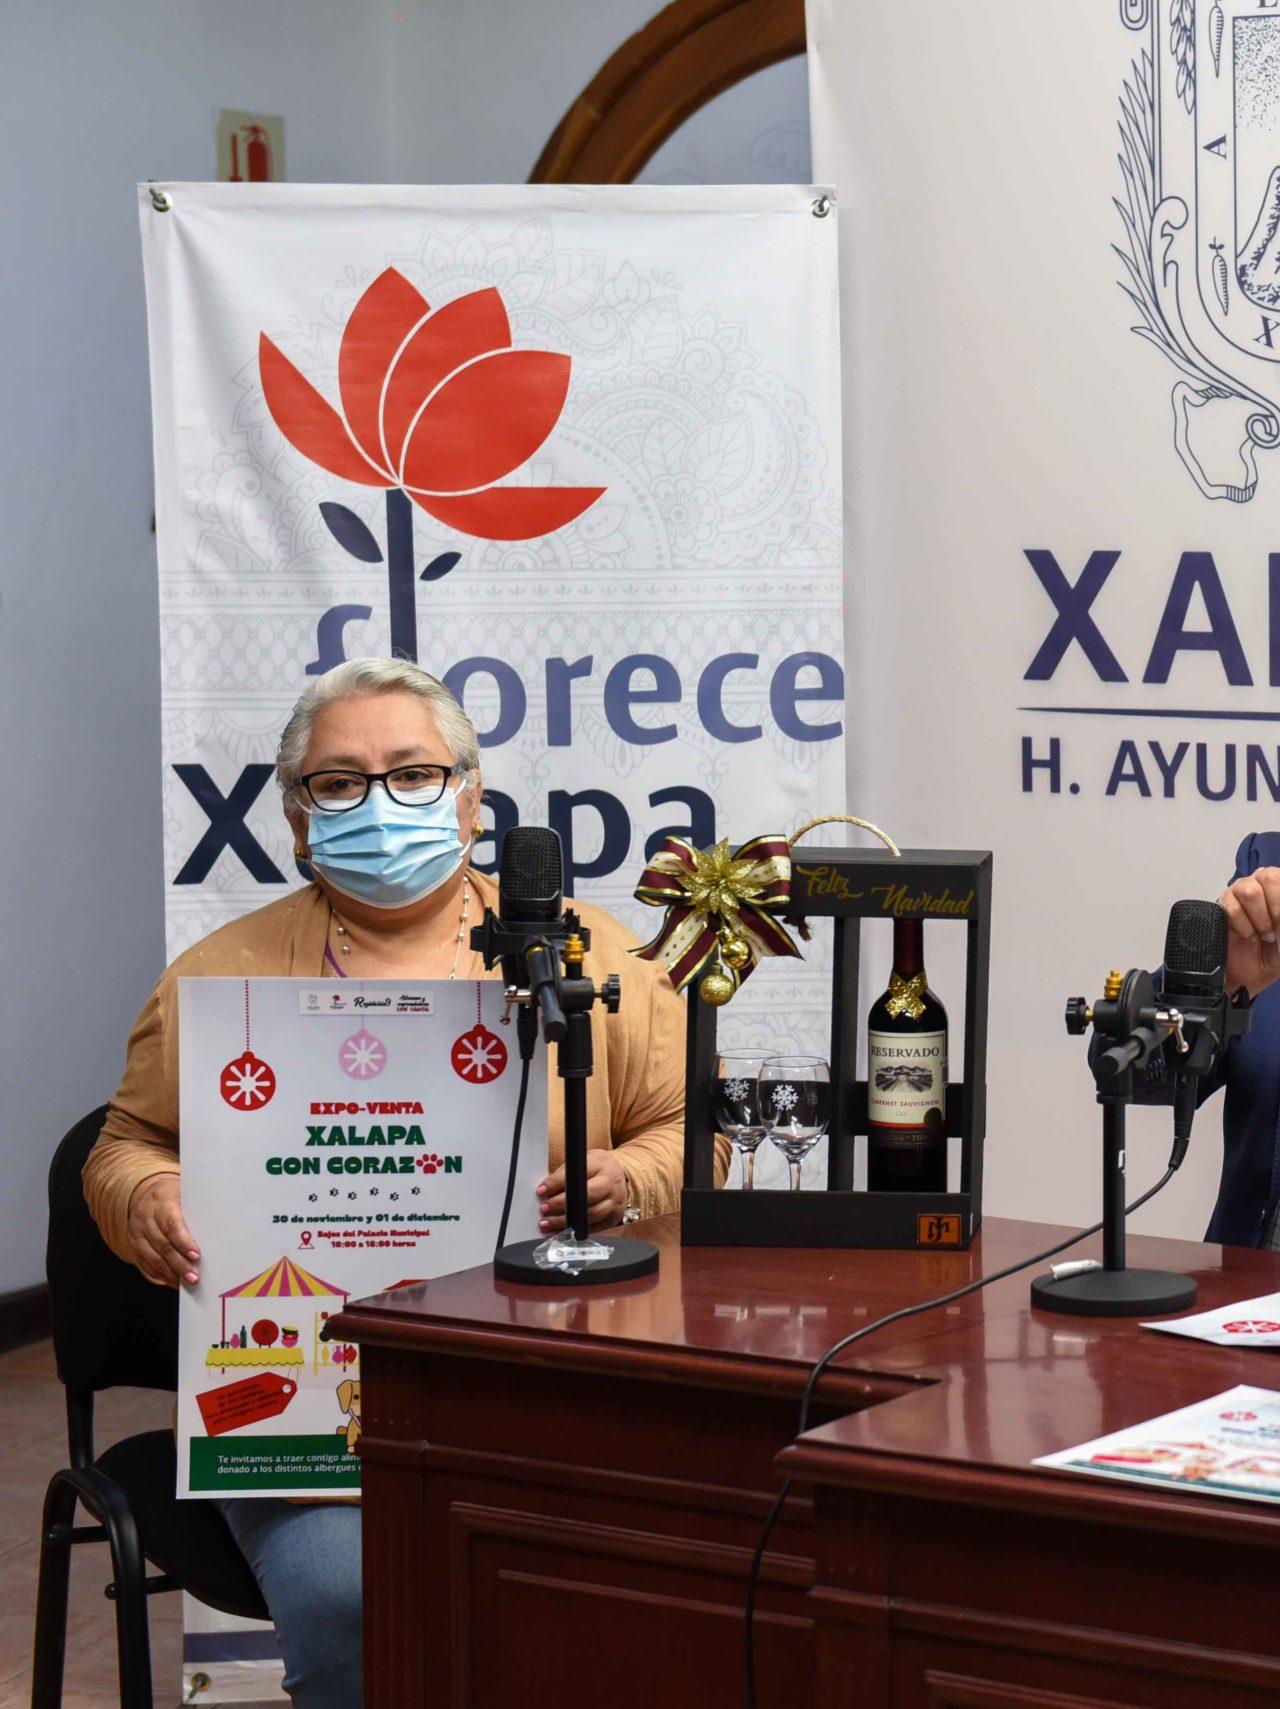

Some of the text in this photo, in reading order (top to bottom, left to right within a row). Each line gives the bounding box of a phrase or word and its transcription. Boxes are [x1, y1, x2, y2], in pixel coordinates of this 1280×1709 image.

[1021, 736, 1081, 795] H.
[172, 763, 716, 900] Xapa
[796, 865, 975, 916] Feliz Navidad
[870, 1045, 940, 1058] RESERVADO
[310, 1102, 424, 1115] EXPO-VENTA
[900, 1099, 939, 1107] SAUVIGNON
[304, 1125, 427, 1146] XALAPA
[265, 1157, 321, 1175] CON
[272, 1213, 460, 1224] 30 de noviembre y 01 de diciembre
[317, 1231, 341, 1239] Bajos
[390, 1229, 430, 1238] Municipal
[217, 1455, 228, 1463] Te
[230, 1454, 273, 1463] invitamos
[306, 1453, 339, 1464] contigo
[217, 1465, 250, 1474] donado
[260, 1465, 272, 1473] los
[274, 1464, 312, 1473] distintos
[314, 1463, 356, 1474] albergues
